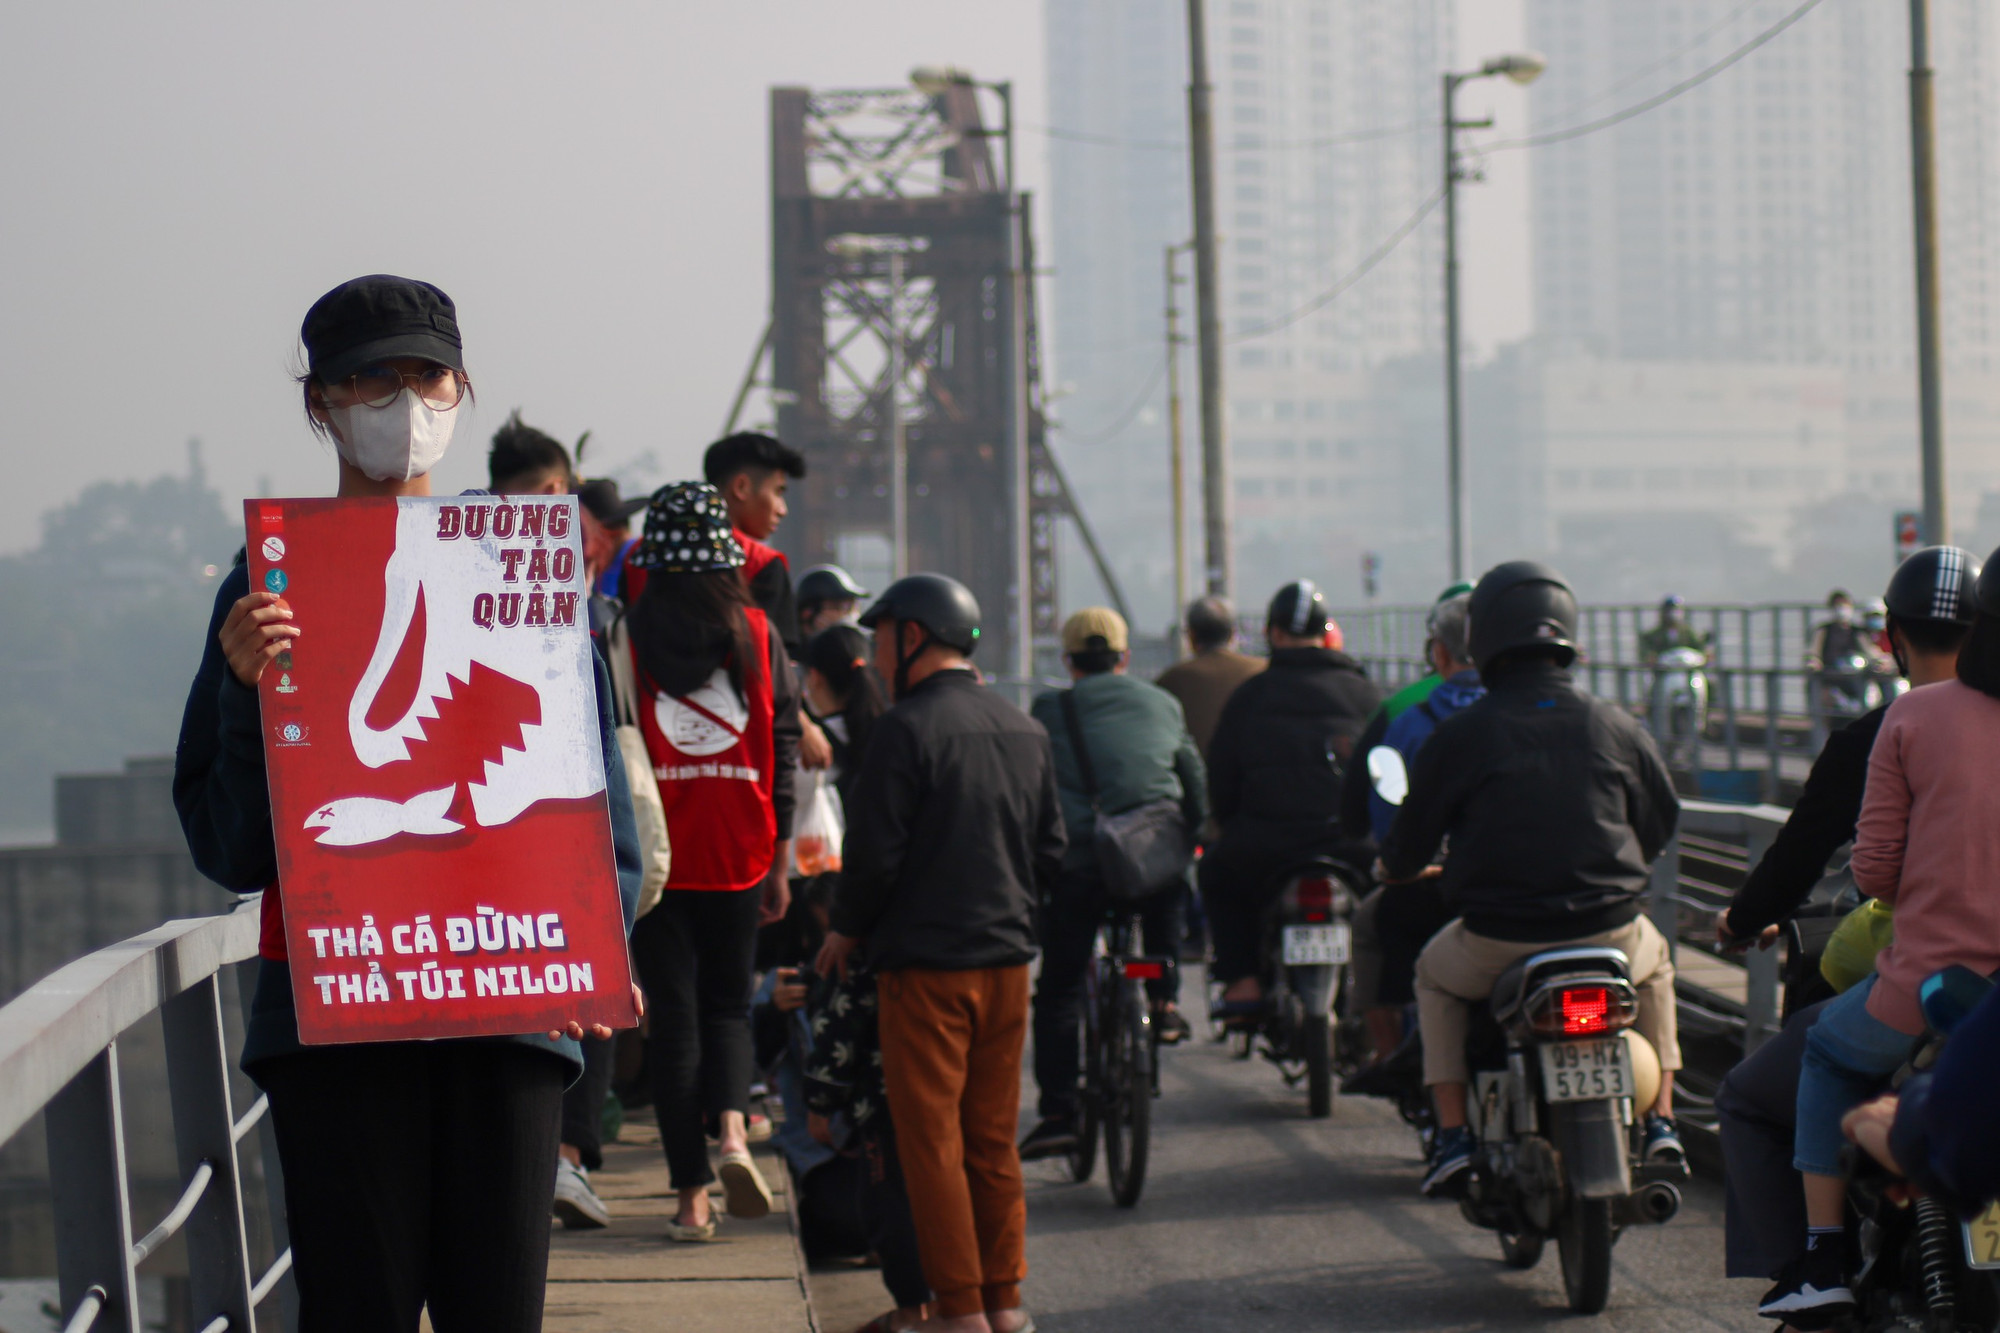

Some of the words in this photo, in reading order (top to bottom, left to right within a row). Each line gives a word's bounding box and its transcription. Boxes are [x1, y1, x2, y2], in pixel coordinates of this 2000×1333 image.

[438, 495, 571, 540] ĐƯỜNG
[500, 541, 576, 583] TÁO
[473, 584, 579, 631] QUÂN
[307, 914, 384, 958] THẢ
[392, 914, 438, 954] CÁ
[445, 906, 568, 953] ĐỪNG
[313, 961, 390, 1005] THẢ
[396, 961, 466, 1001] TÚI
[474, 962, 594, 997] NILON
[1557, 1069, 1623, 1098] 5253
